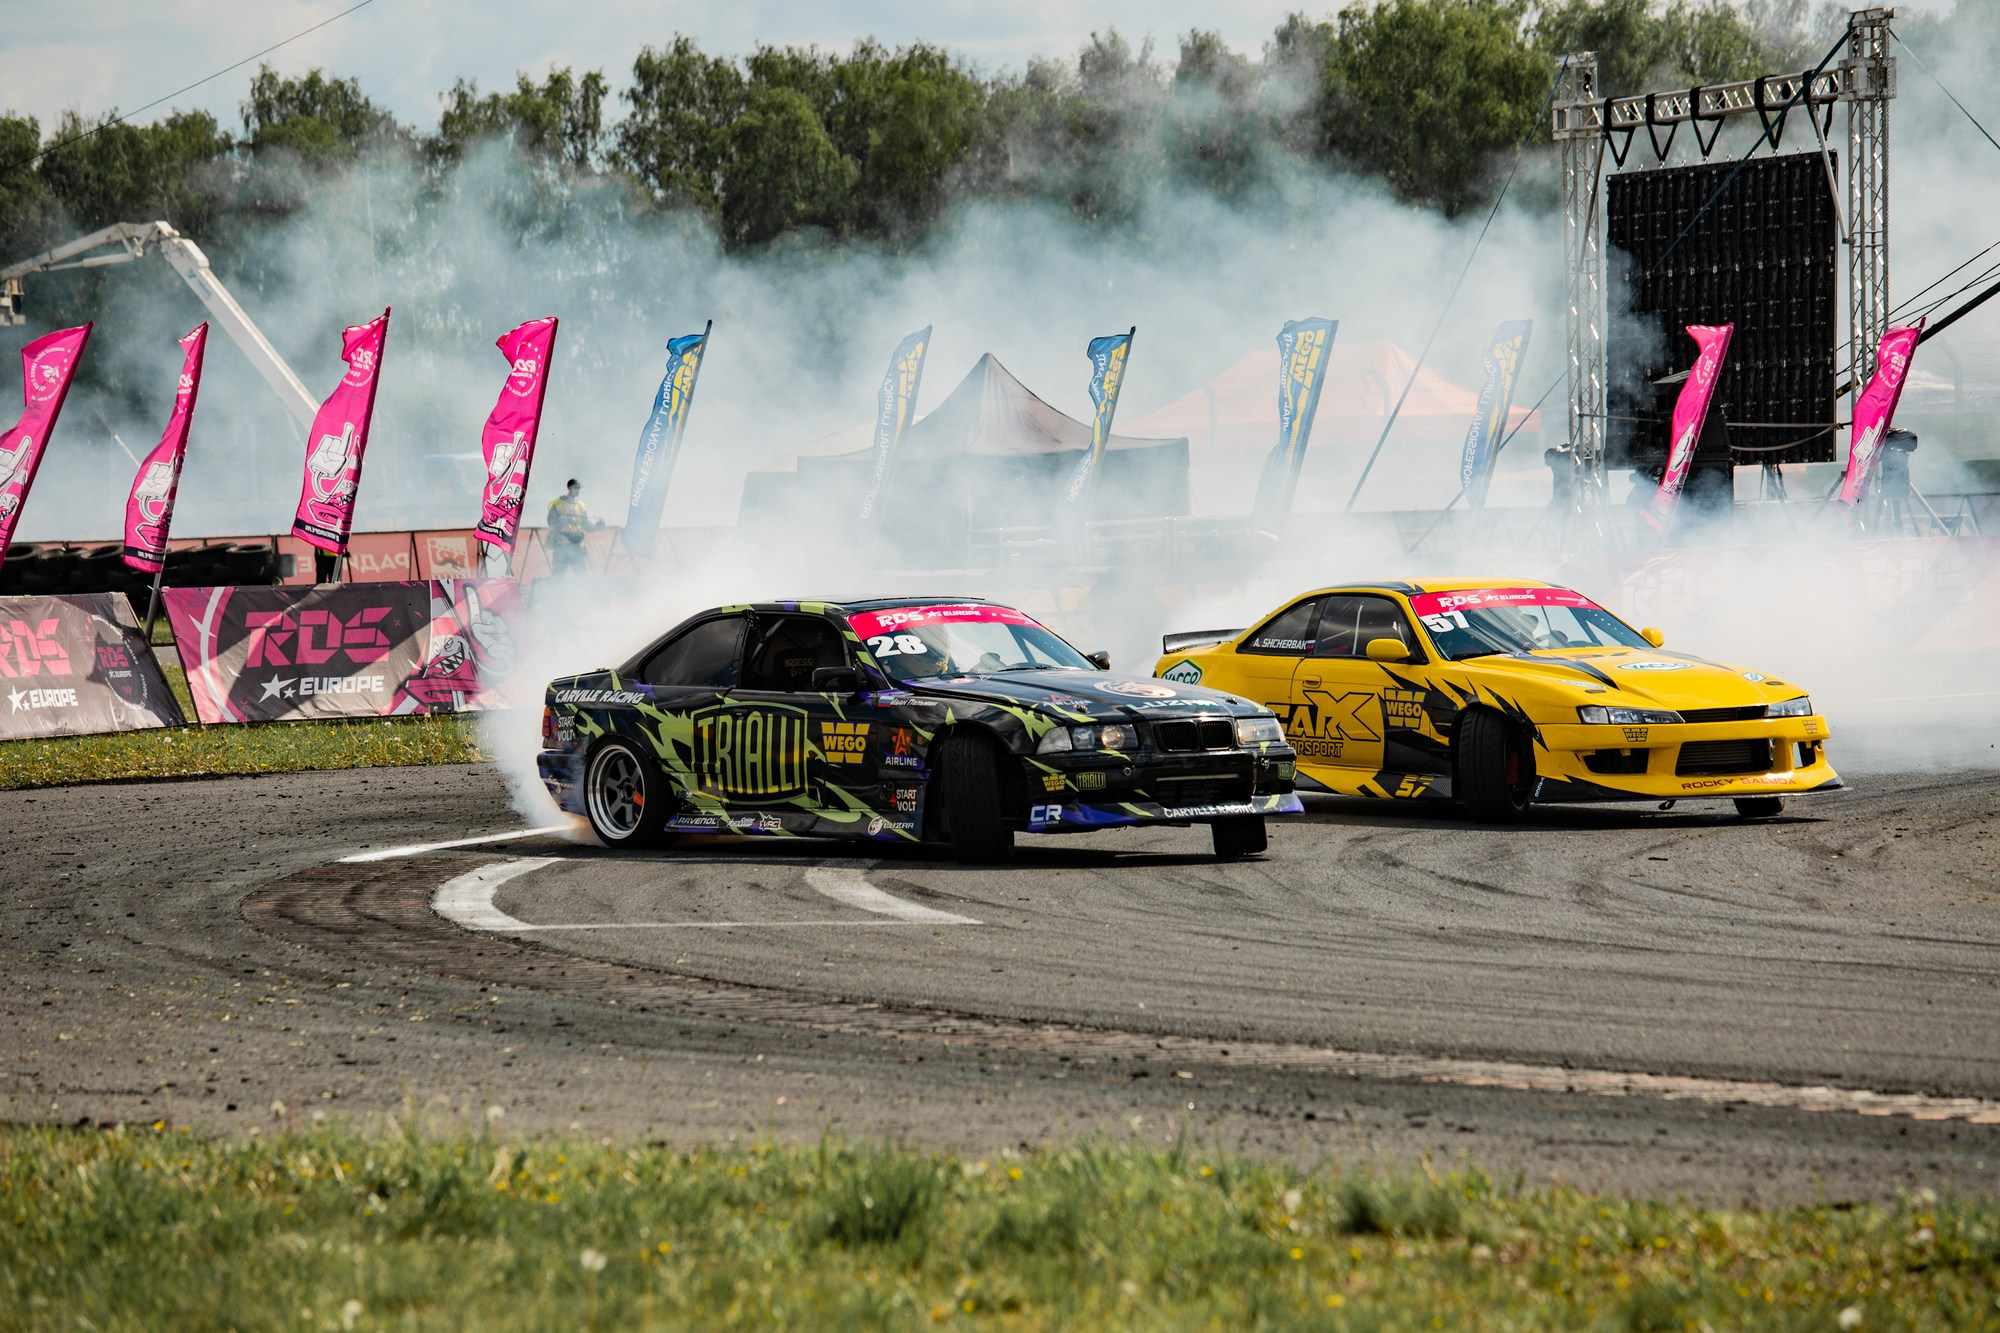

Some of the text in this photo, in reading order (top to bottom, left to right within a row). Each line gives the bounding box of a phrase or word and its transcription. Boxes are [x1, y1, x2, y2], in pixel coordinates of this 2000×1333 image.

[1437, 594, 1482, 608] RDS
[1498, 594, 1536, 602] EUROPE
[876, 611, 924, 627] RDS
[942, 609, 982, 618] EUROPE
[1420, 610, 1471, 633] 57
[246, 606, 393, 668] RDS
[1262, 638, 1308, 650] SHCHERBAK
[867, 635, 928, 658] 28
[97, 646, 129, 667] RDS
[299, 675, 385, 696] EUROPE
[29, 688, 80, 709] EUROPE
[555, 689, 646, 705] CARVILLE RACING
[1385, 701, 1422, 718] WEGO
[557, 729, 574, 743] VOLT
[823, 734, 867, 752] WEGO
[885, 756, 918, 767] AIRLINE
[1044, 779, 1065, 787] WEGO
[1079, 774, 1104, 789] TRIALLI
[1394, 775, 1434, 798] 57
[1681, 778, 1735, 791] ROCKY
[896, 789, 918, 800] START
[897, 801, 917, 812] VOLT
[1030, 804, 1062, 822] CR
[1164, 805, 1217, 818] CARVILLE
[1218, 802, 1256, 813] RACING
[677, 816, 718, 826] RAVENOL
[882, 821, 915, 830] LUZAR
